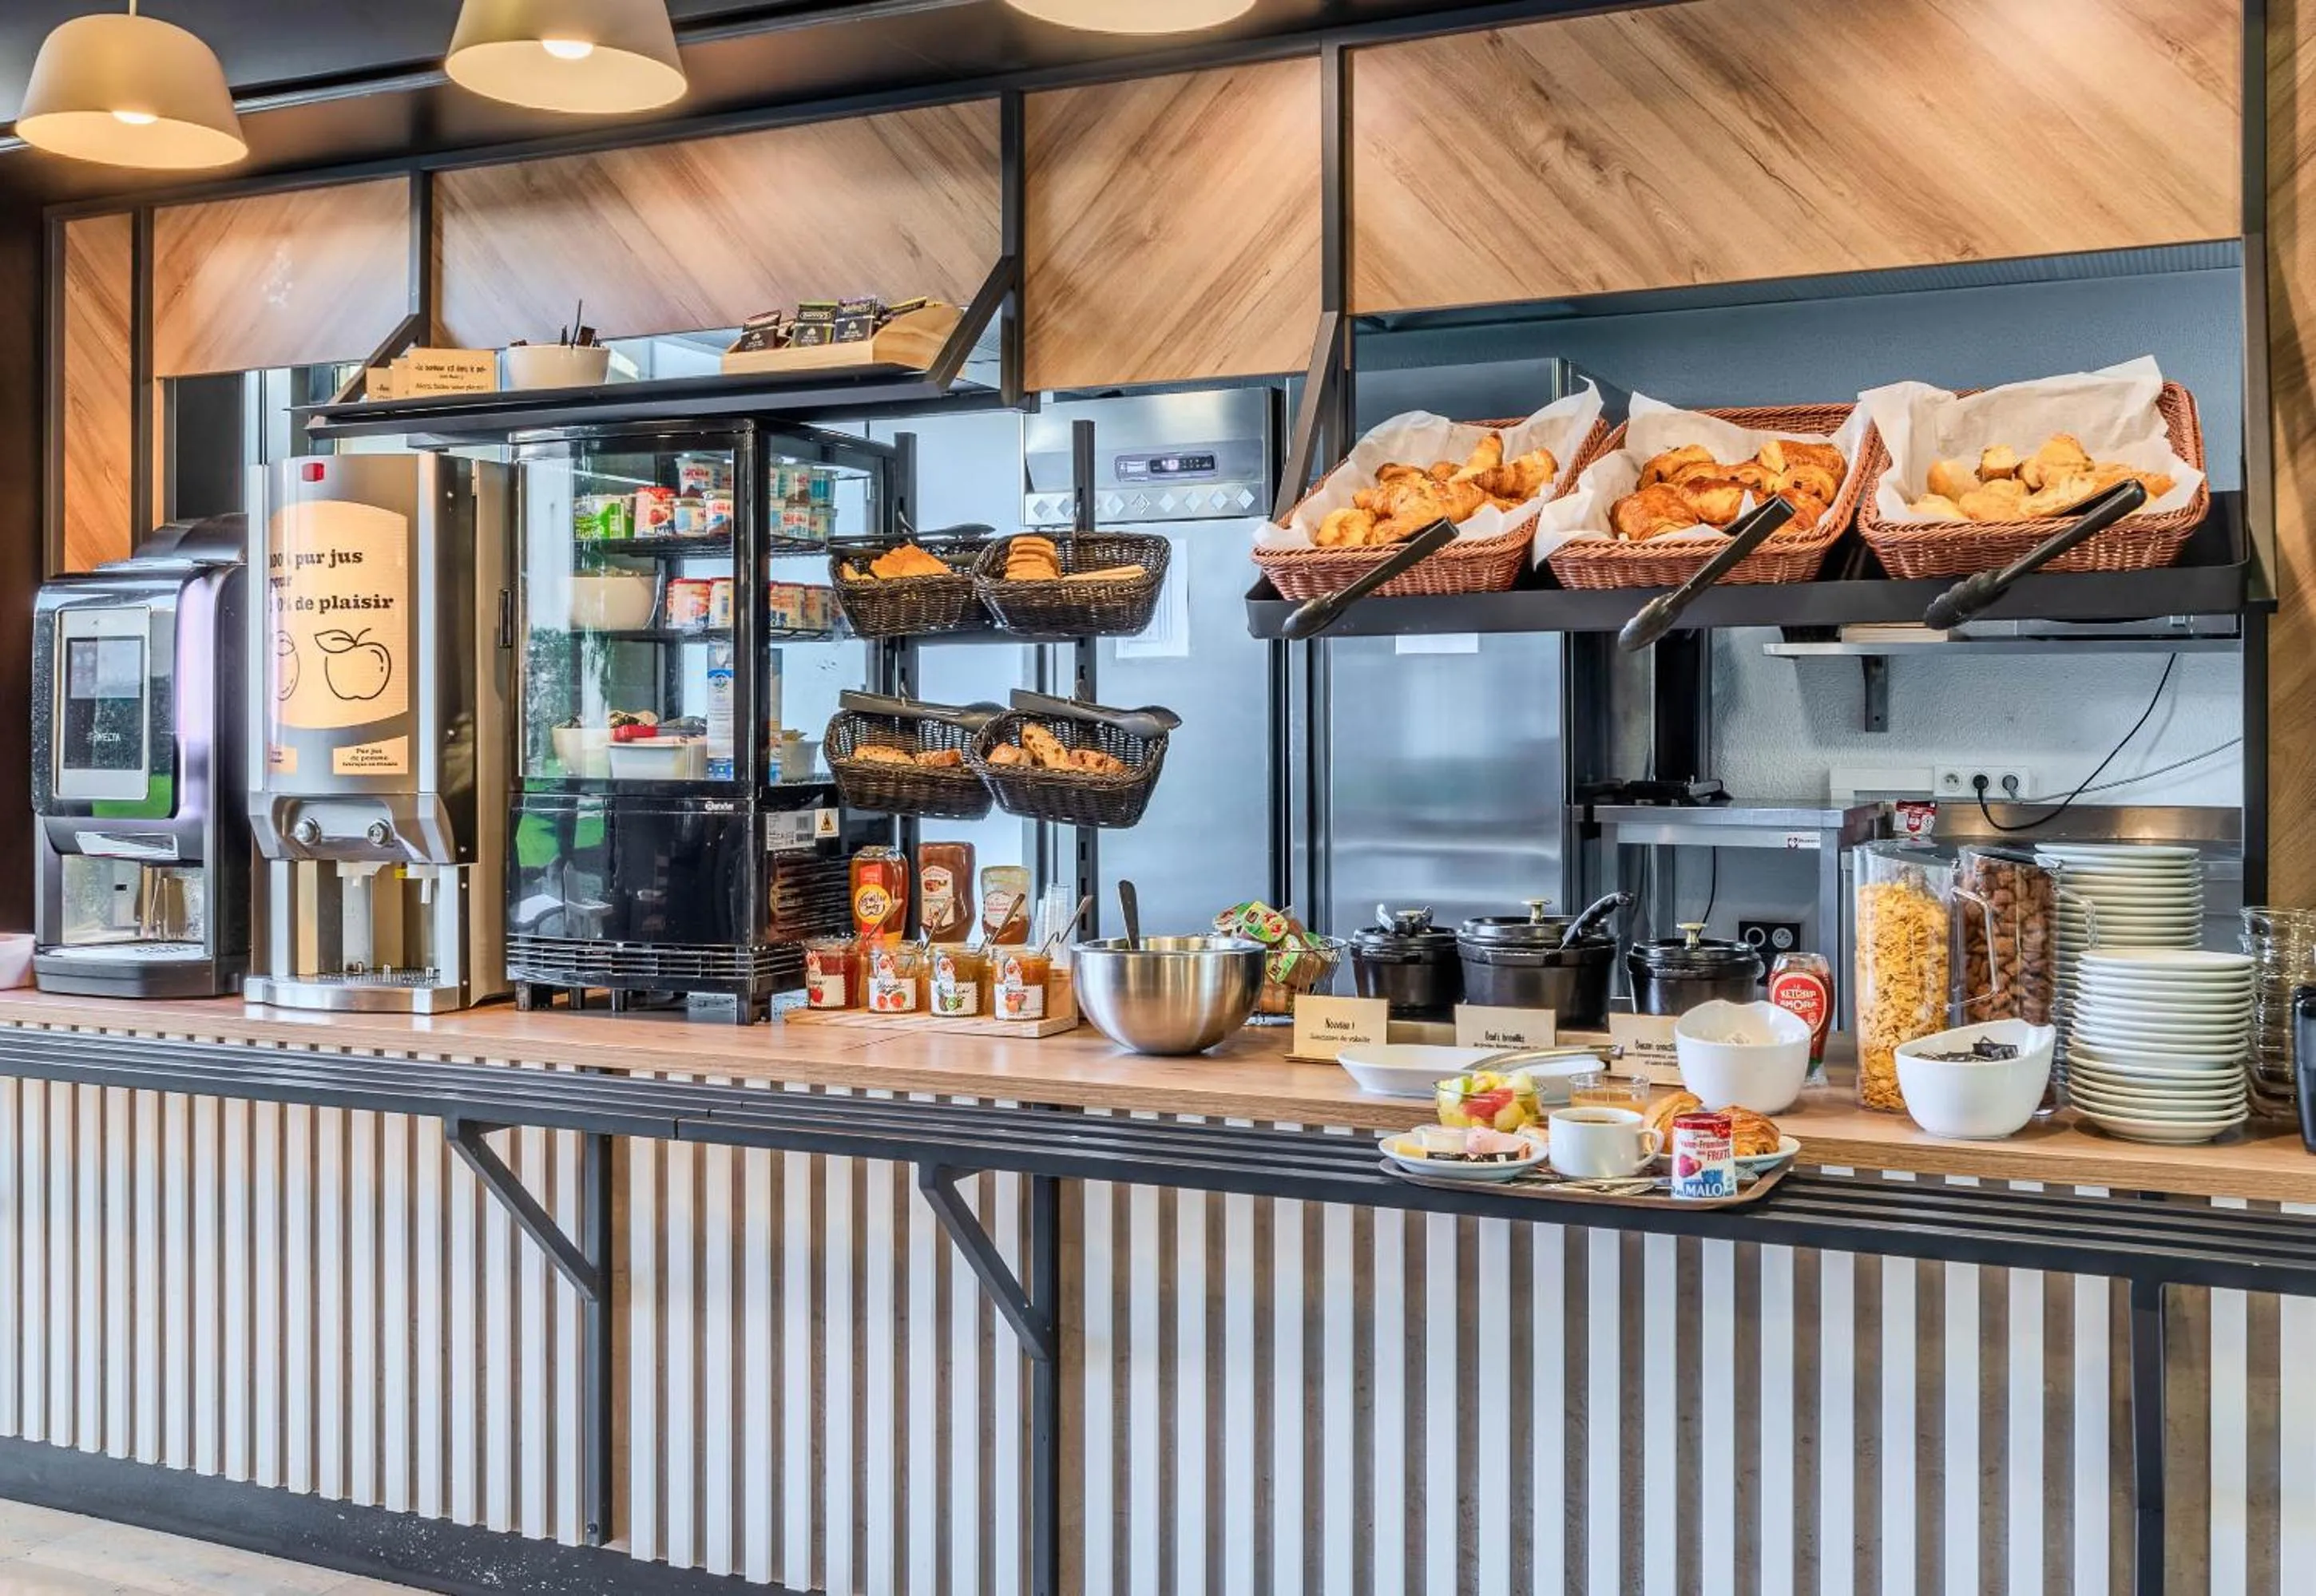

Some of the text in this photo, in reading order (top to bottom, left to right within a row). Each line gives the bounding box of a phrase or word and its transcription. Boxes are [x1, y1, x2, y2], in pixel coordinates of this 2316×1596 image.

[295, 553, 325, 569] pur
[328, 549, 363, 568] jus
[295, 597, 315, 611] de
[319, 594, 395, 614] plaisir
[1780, 989, 1817, 999] KETCHUP
[1779, 1000, 1817, 1010] AMORA
[1686, 1182, 1723, 1197] MALO
